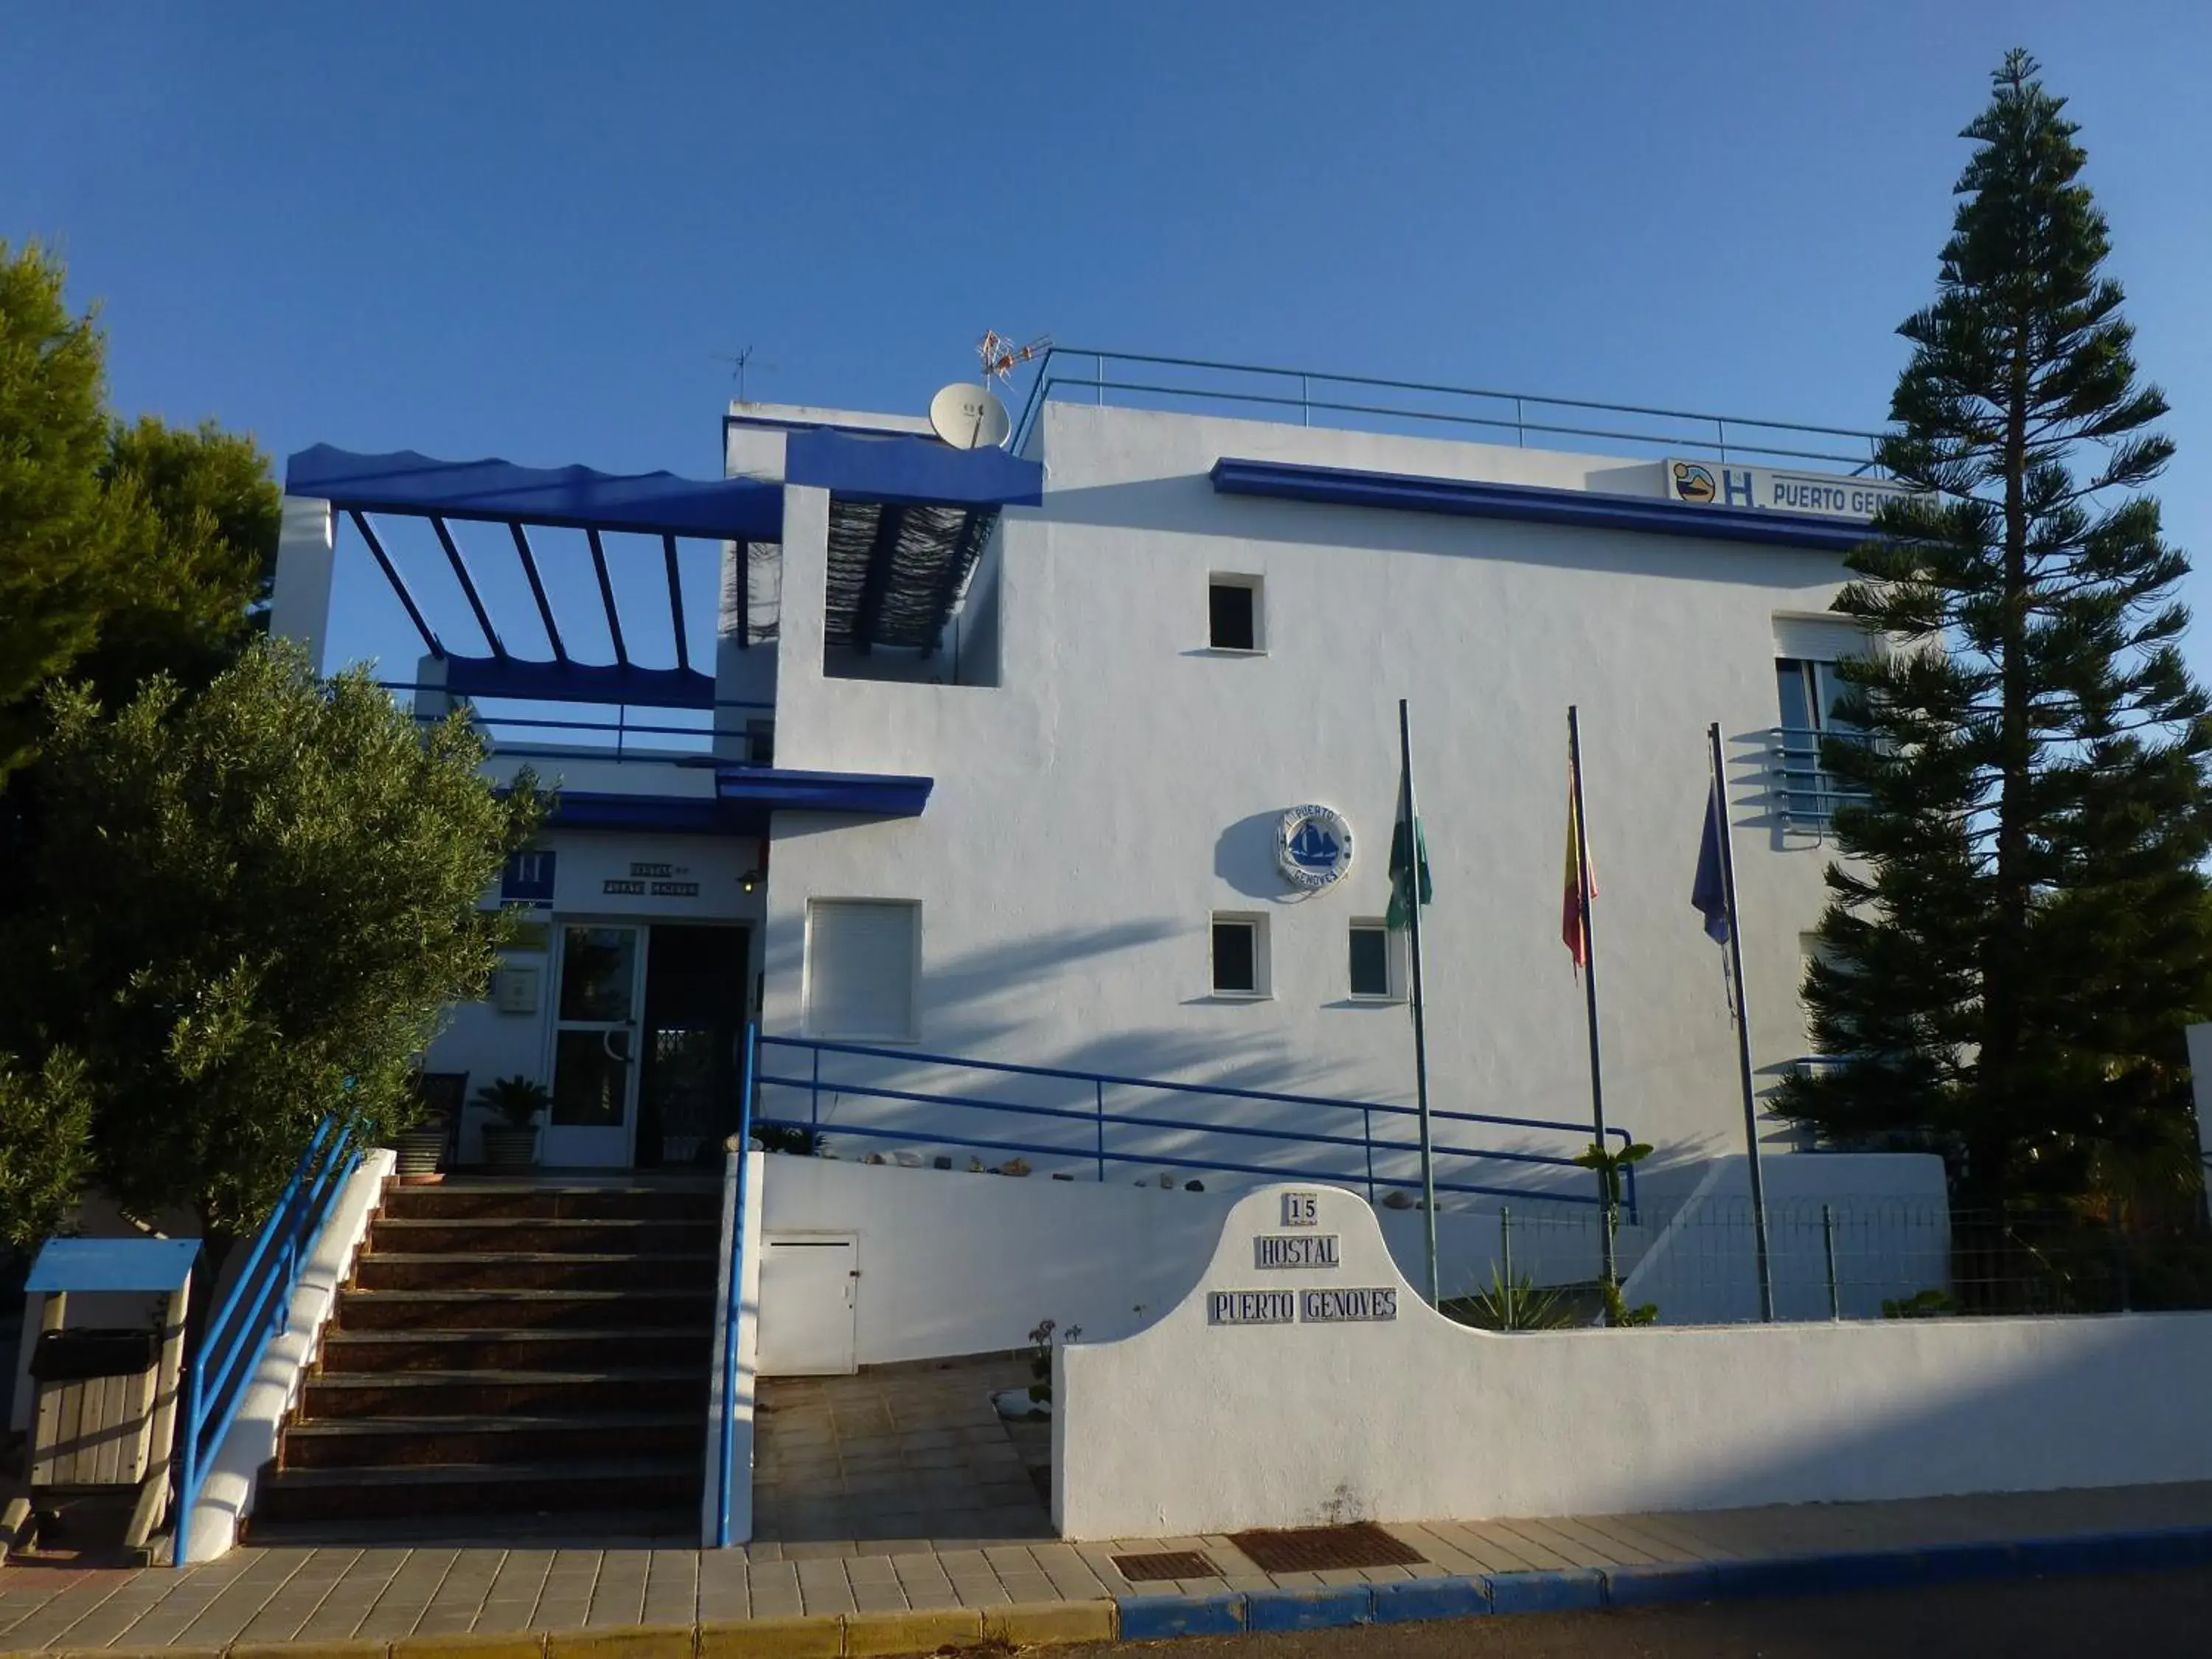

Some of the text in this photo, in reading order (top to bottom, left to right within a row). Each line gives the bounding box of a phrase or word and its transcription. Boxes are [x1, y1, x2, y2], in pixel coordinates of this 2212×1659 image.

[1773, 483, 1845, 511] PUERTO
[1291, 1200, 1315, 1217] 15
[1262, 1238, 1340, 1265] HOSTAL
[1216, 1290, 1397, 1320] PUERTO GENOVES
